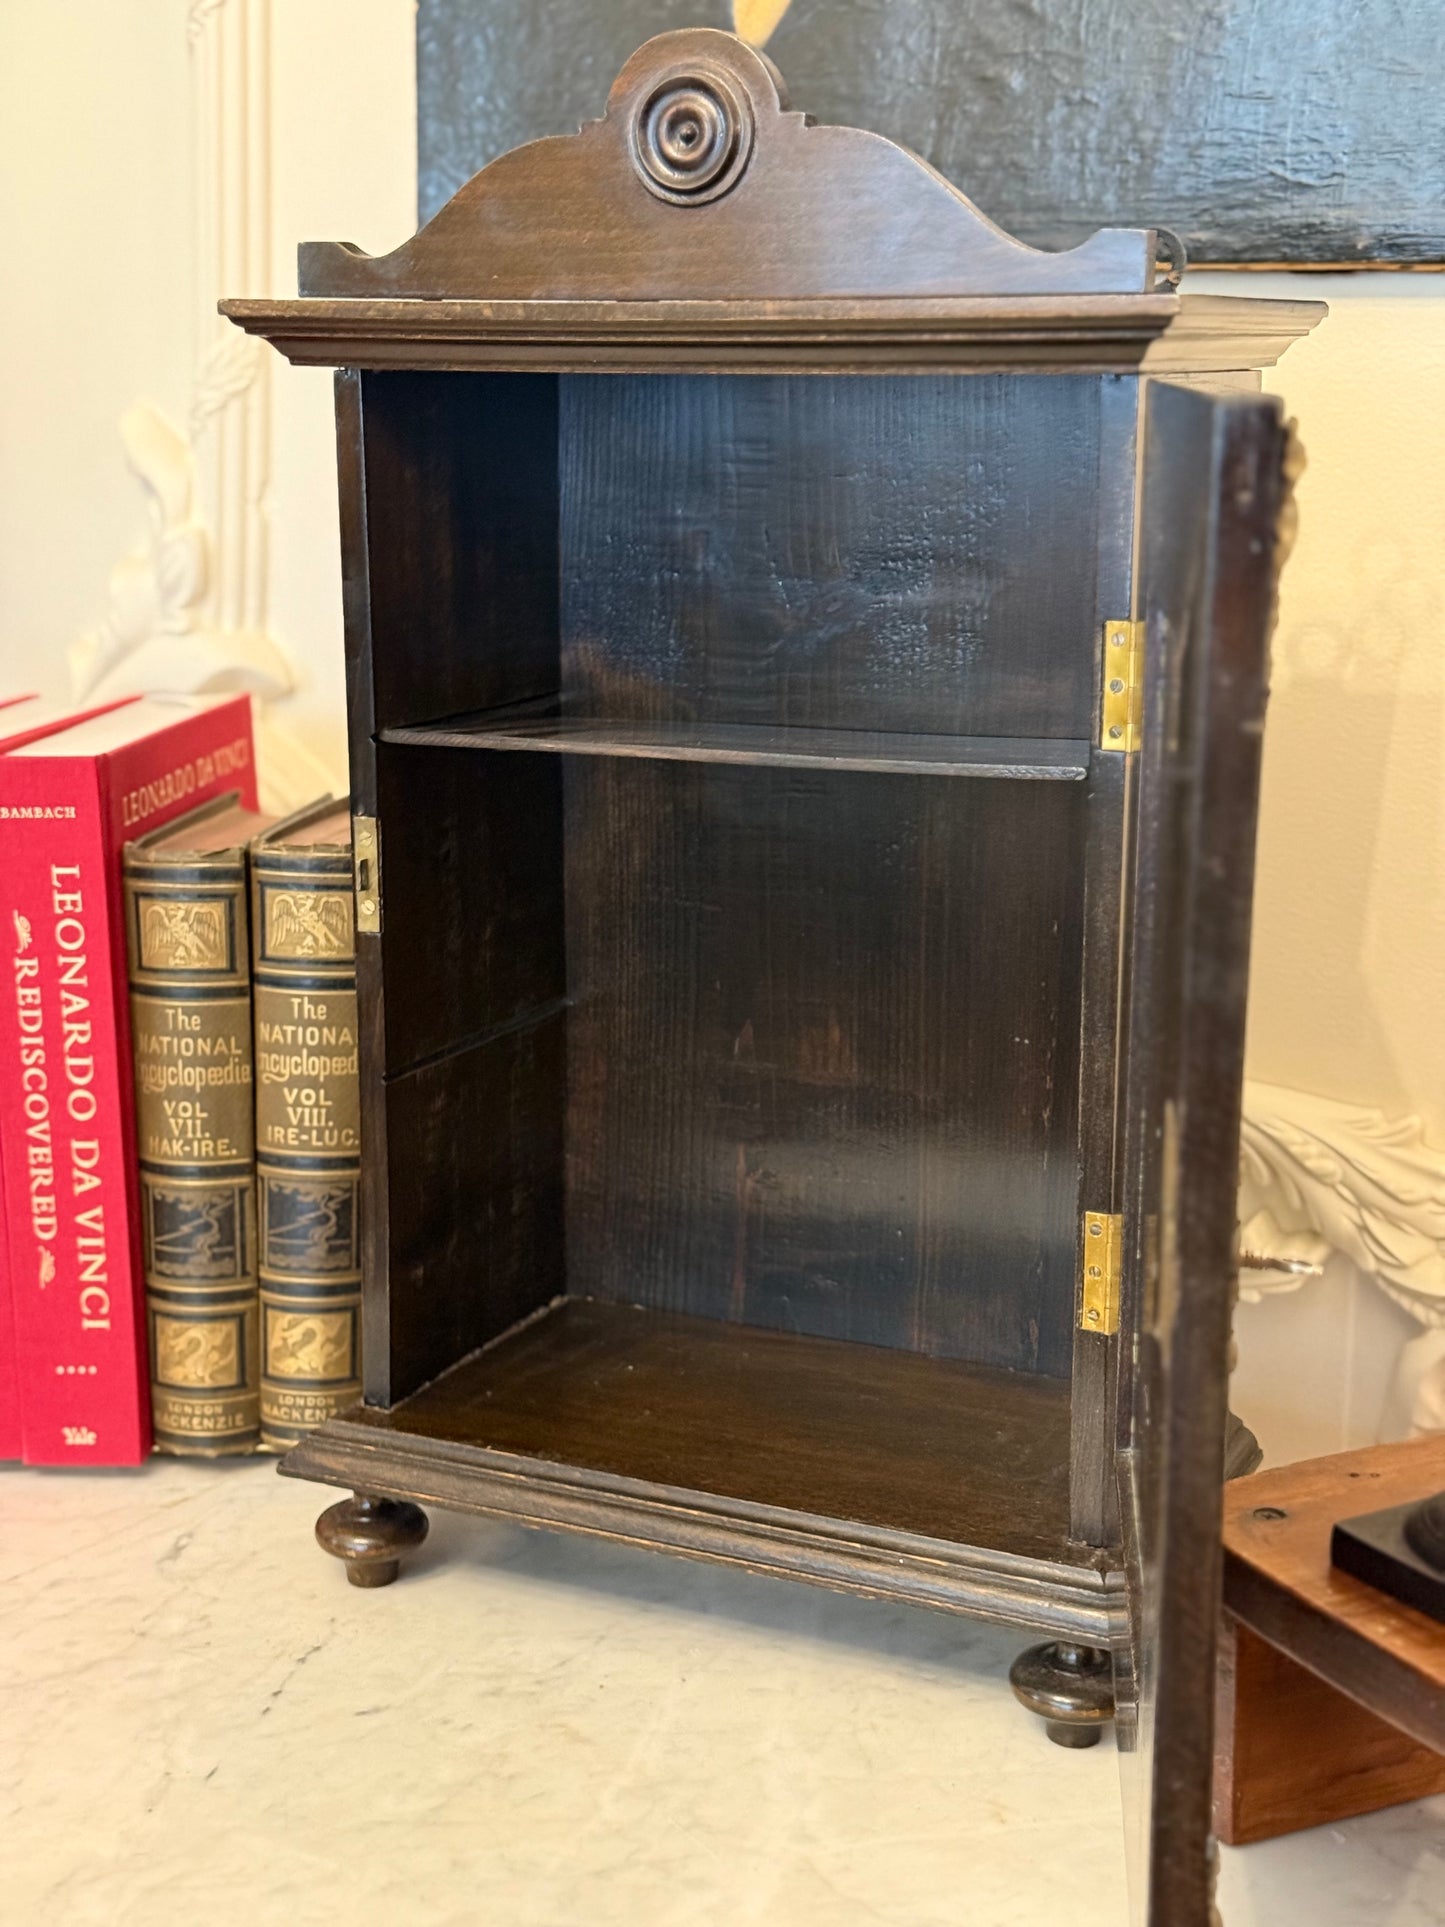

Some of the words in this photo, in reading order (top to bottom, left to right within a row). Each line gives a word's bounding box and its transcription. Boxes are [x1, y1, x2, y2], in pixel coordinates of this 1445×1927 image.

[122, 763, 196, 827] LEONARDO
[0, 806, 76, 819] BAMBACH
[51, 864, 97, 1121] LEONARDO
[290, 997, 327, 1020] The
[165, 1008, 201, 1031] The
[260, 1022, 354, 1045] NATIONA
[139, 1033, 242, 1057] NATIONAL
[14, 957, 58, 1240] REDISCOVERED
[283, 1088, 332, 1106] VOL
[163, 1101, 208, 1118] VOL
[287, 1107, 333, 1127] VIII.
[169, 1118, 210, 1138] VII.
[267, 1126, 359, 1147] IRE-LUC.
[149, 1136, 237, 1156] HAK-IRE.
[71, 1139, 102, 1196] DA
[74, 1205, 110, 1330] VINCI
[168, 1402, 223, 1415] LONDON
[278, 1394, 336, 1406] LONDON
[62, 1426, 97, 1445] Yale
